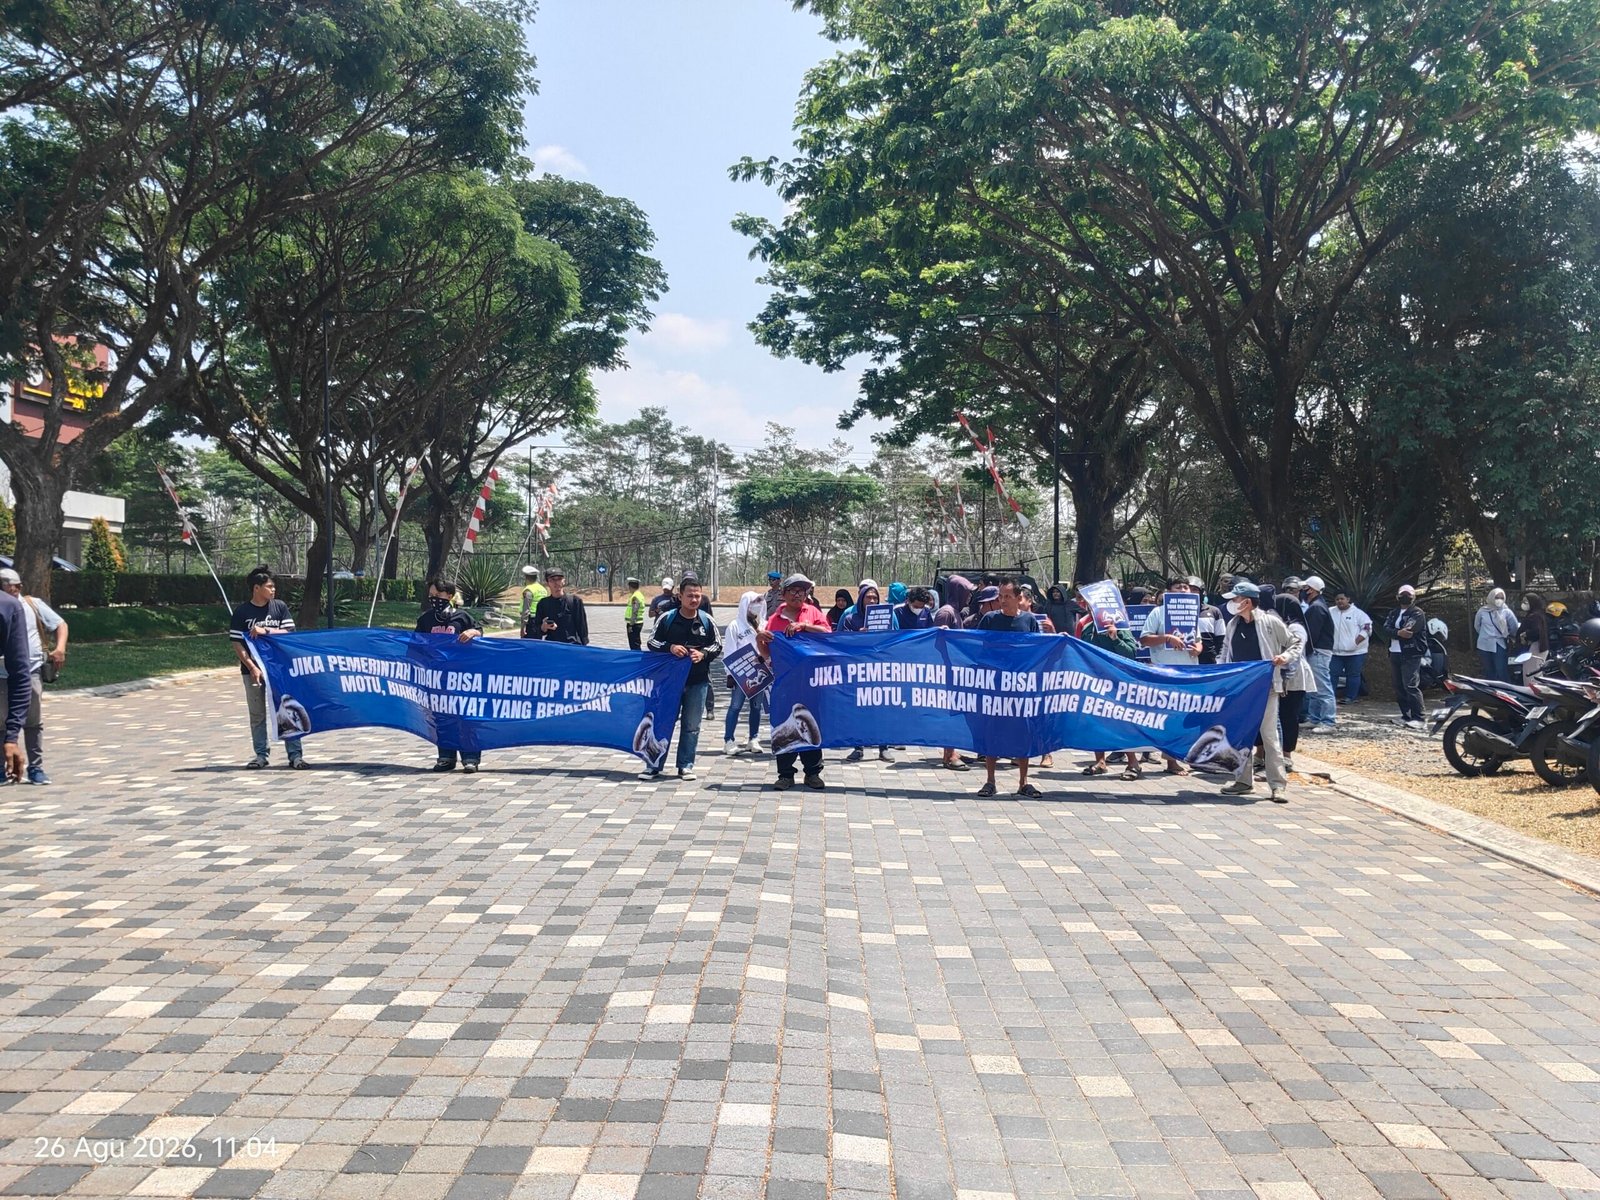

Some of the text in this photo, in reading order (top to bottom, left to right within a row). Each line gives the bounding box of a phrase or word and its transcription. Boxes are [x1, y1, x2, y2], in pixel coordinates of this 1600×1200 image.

[289, 655, 325, 678] JIKA
[327, 655, 411, 681] PEMERINTAH
[413, 665, 442, 690] TIDAK
[447, 671, 482, 693] BISA
[487, 674, 561, 698] MENUTUP
[340, 675, 387, 696] MOTU,
[430, 694, 487, 718] RAKYAT
[492, 699, 531, 719] YANG
[809, 662, 1226, 713] JIKA PEMERINTAH TIDAK BISA MENUTUP PERUSAHAAN
[856, 687, 1168, 730] MOTU, BIARKAN RAKYAT YANG BERGERAK
